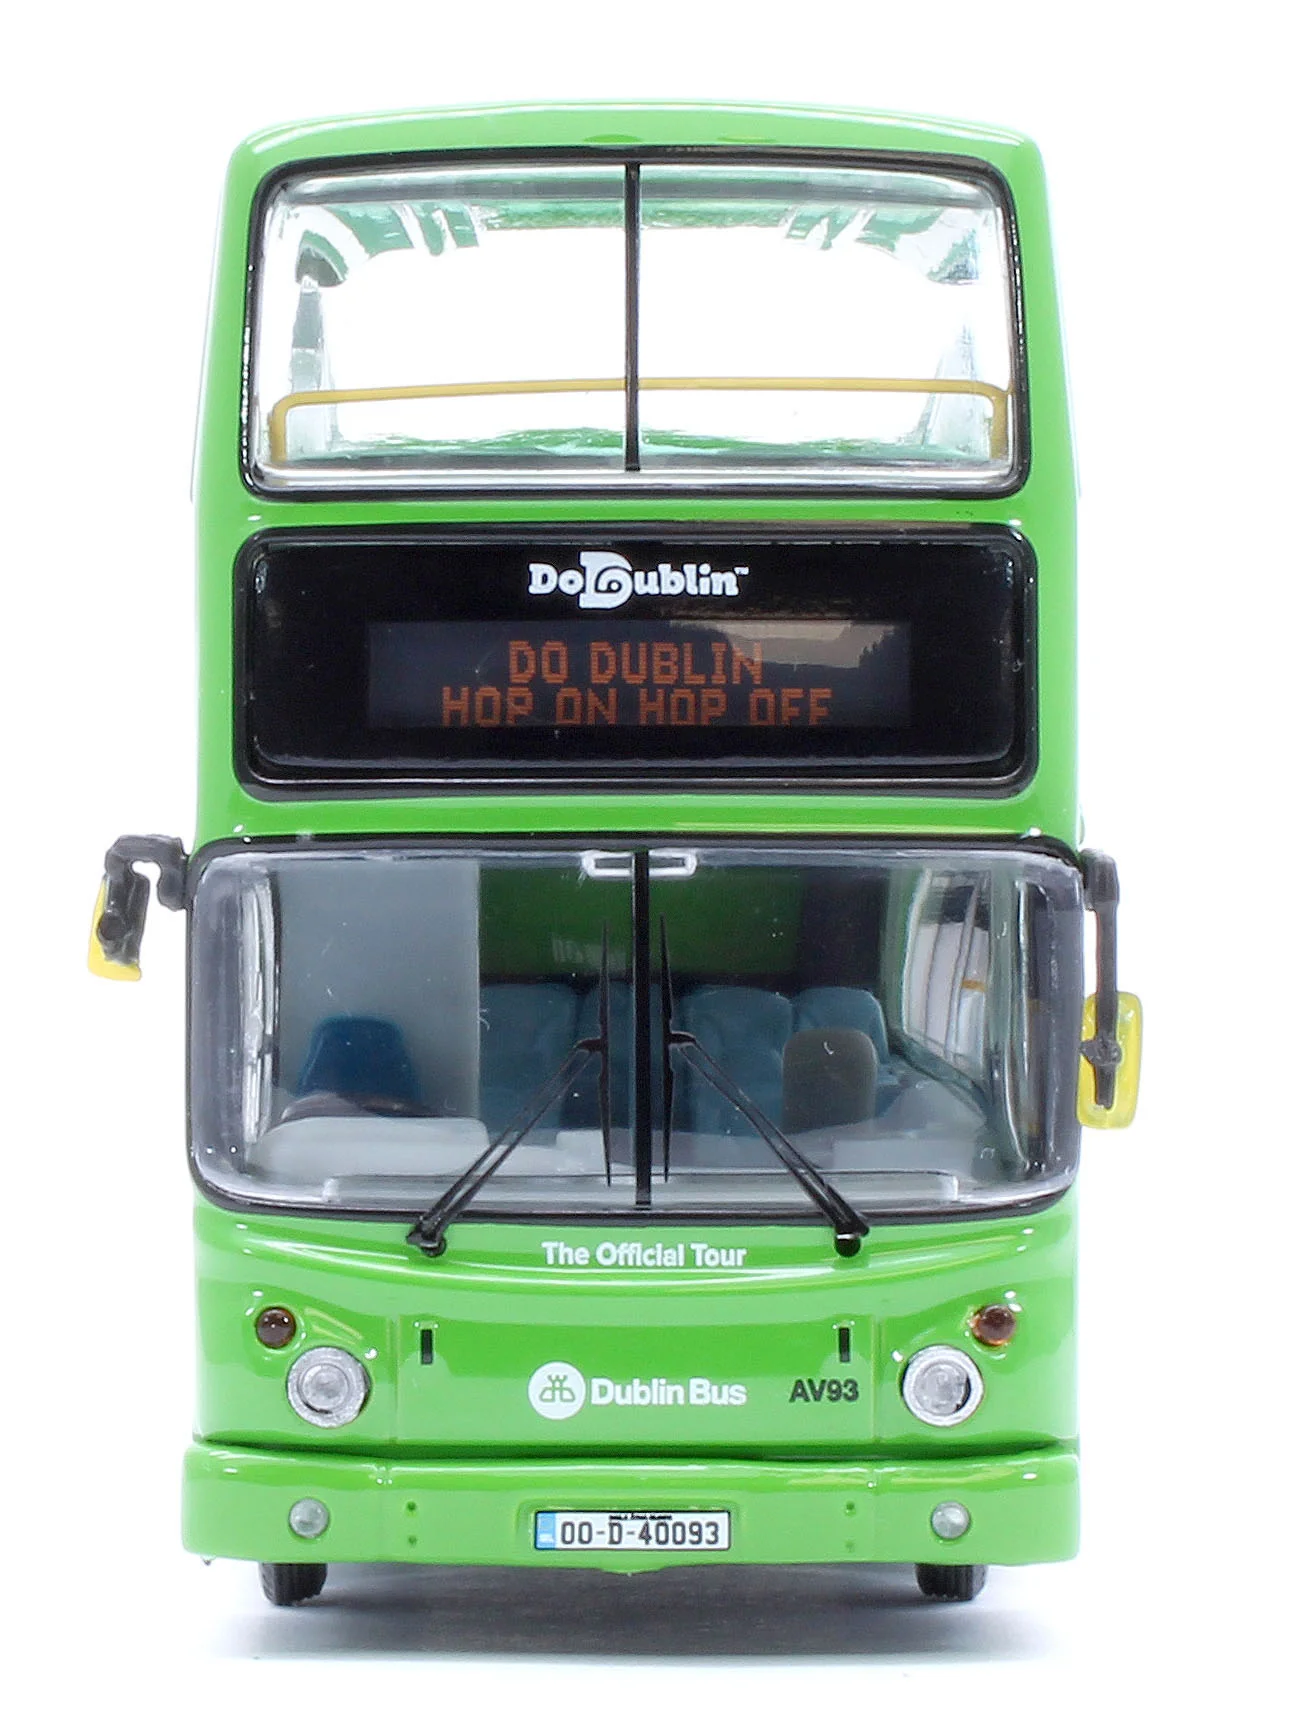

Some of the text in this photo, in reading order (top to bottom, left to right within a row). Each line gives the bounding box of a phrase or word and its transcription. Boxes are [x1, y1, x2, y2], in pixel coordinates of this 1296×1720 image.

[509, 641, 763, 684] DO DUBLIN
[442, 687, 833, 727] HOP ON HOP OFF
[541, 1241, 747, 1267] The Official Tour
[591, 1378, 747, 1406] Dublin Bus
[789, 1379, 859, 1402] AV93
[561, 1521, 719, 1545] 00-D-40093
